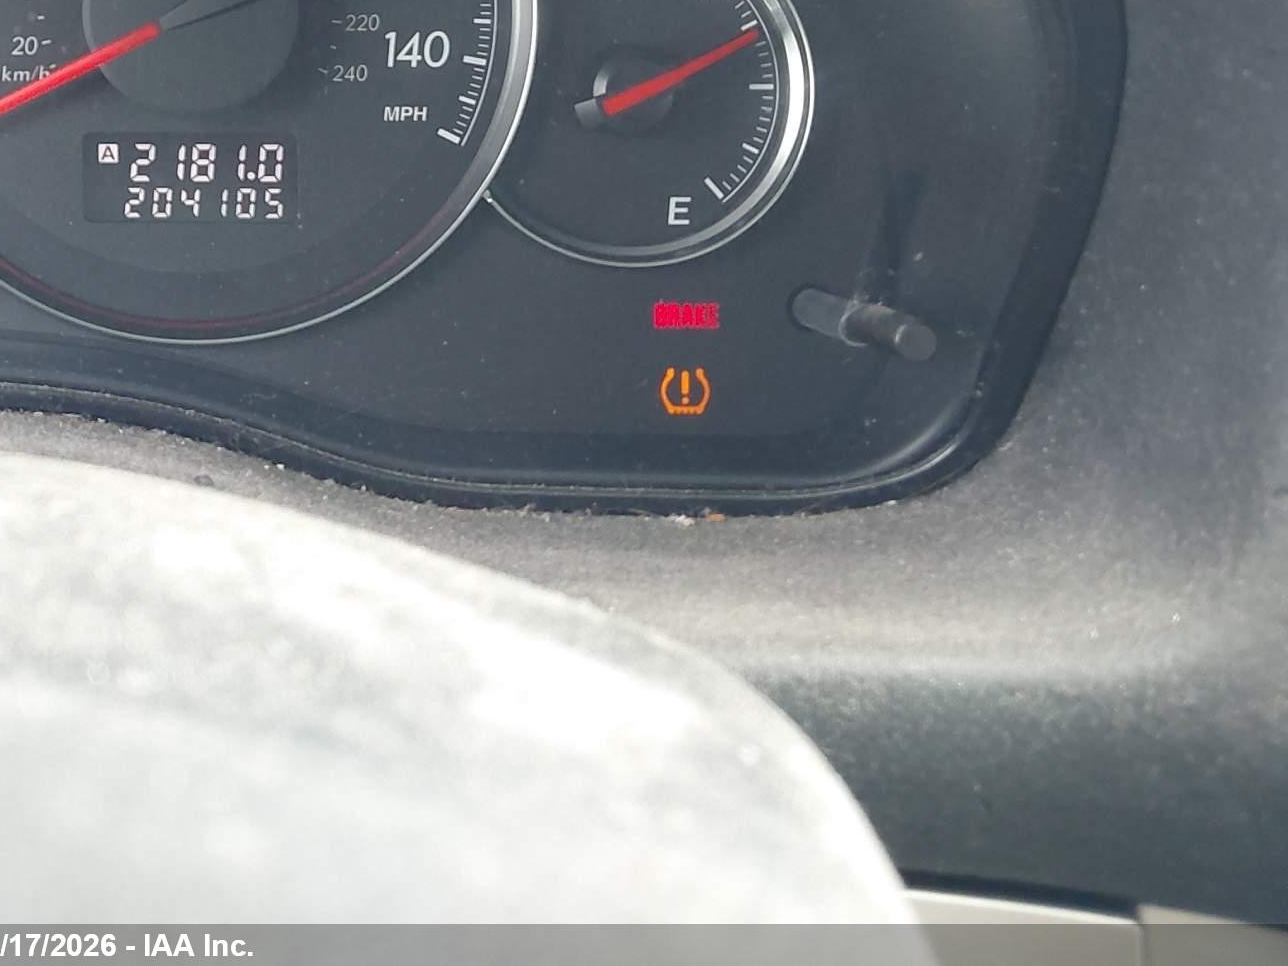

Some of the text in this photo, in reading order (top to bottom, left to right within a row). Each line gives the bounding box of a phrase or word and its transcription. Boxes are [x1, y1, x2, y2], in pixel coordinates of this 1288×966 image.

[346, 14, 380, 31] 220
[12, 37, 38, 55] 20
[385, 31, 449, 67] 140
[333, 65, 367, 81] 240
[384, 107, 427, 121] MPH
[130, 144, 283, 182] 2181.0
[125, 188, 282, 218] 204105
[668, 197, 691, 224] E
[654, 302, 718, 328] BRAKE
